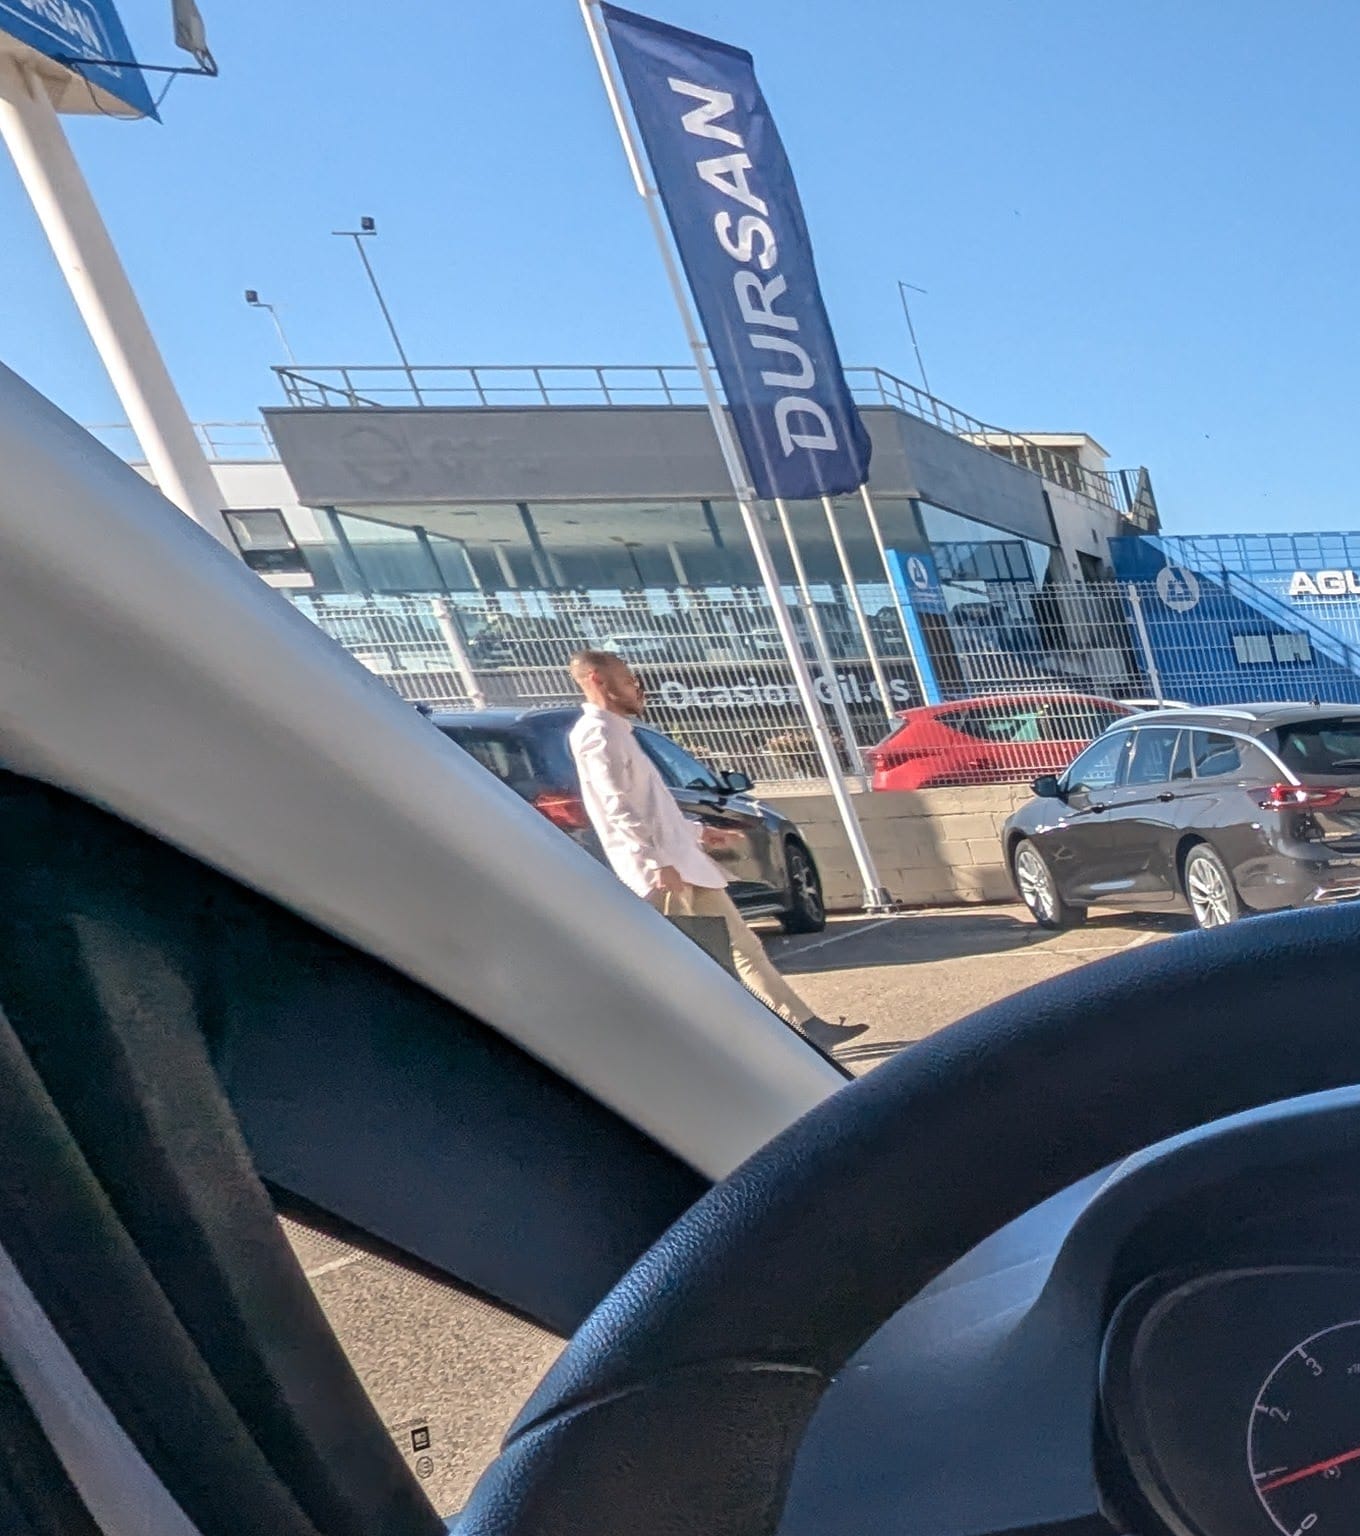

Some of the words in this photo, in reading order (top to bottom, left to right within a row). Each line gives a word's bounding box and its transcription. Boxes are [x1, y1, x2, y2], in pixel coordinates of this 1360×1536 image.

[668, 77, 838, 458] DURSAN
[1305, 1357, 1323, 1376] 3
[1269, 1407, 1291, 1422] 2
[1301, 1513, 1318, 1531] 0
